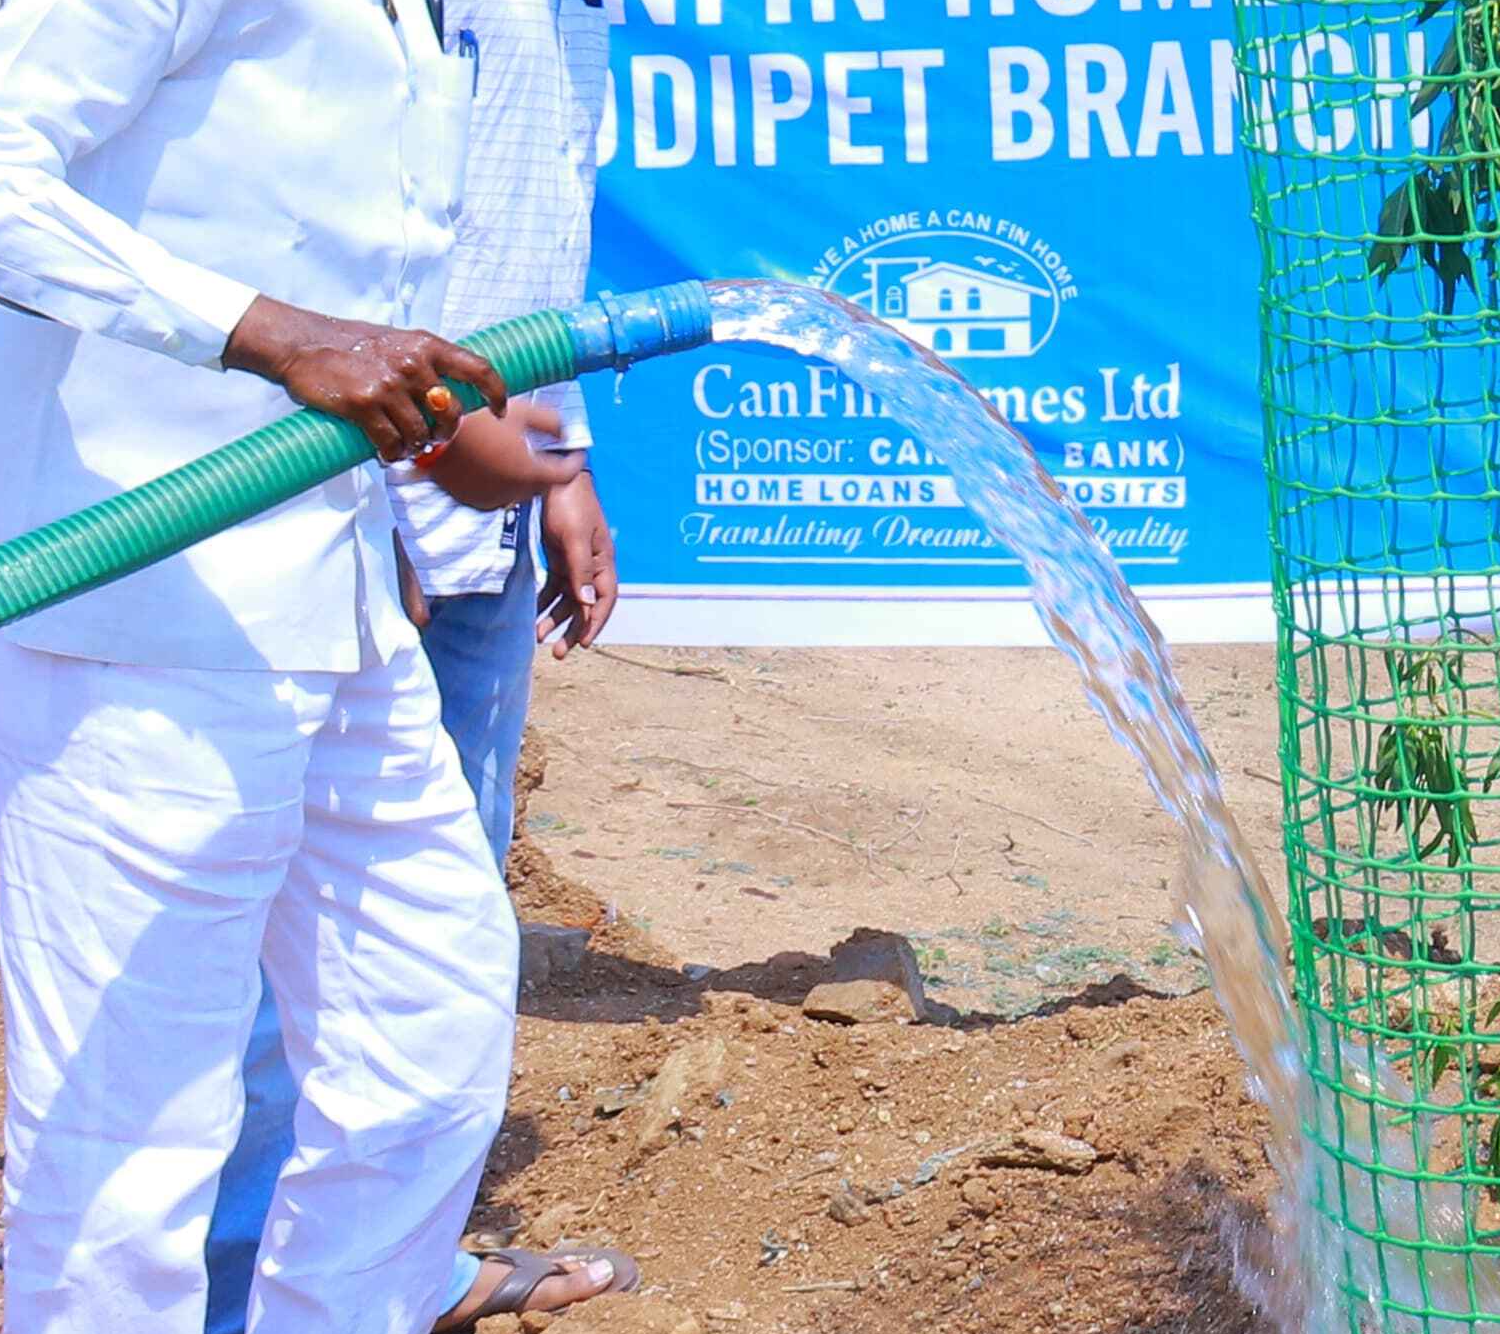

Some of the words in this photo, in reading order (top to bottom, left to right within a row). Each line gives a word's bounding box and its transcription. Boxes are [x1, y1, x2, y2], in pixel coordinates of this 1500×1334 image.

[596, 48, 946, 170] DIPET
[987, 30, 1430, 163] BRANCH
[842, 235, 859, 255] A
[860, 210, 922, 244] HOME
[926, 210, 943, 227] A
[946, 208, 992, 232] CAN
[995, 218, 1031, 246] FIN
[1031, 238, 1079, 301] HOME
[1098, 361, 1181, 423] Ltd
[695, 428, 855, 471] (Sponsor:
[1063, 432, 1186, 474] BANK)
[704, 479, 804, 502] HOME
[819, 479, 936, 503] LOANS
[679, 511, 863, 554] Translating
